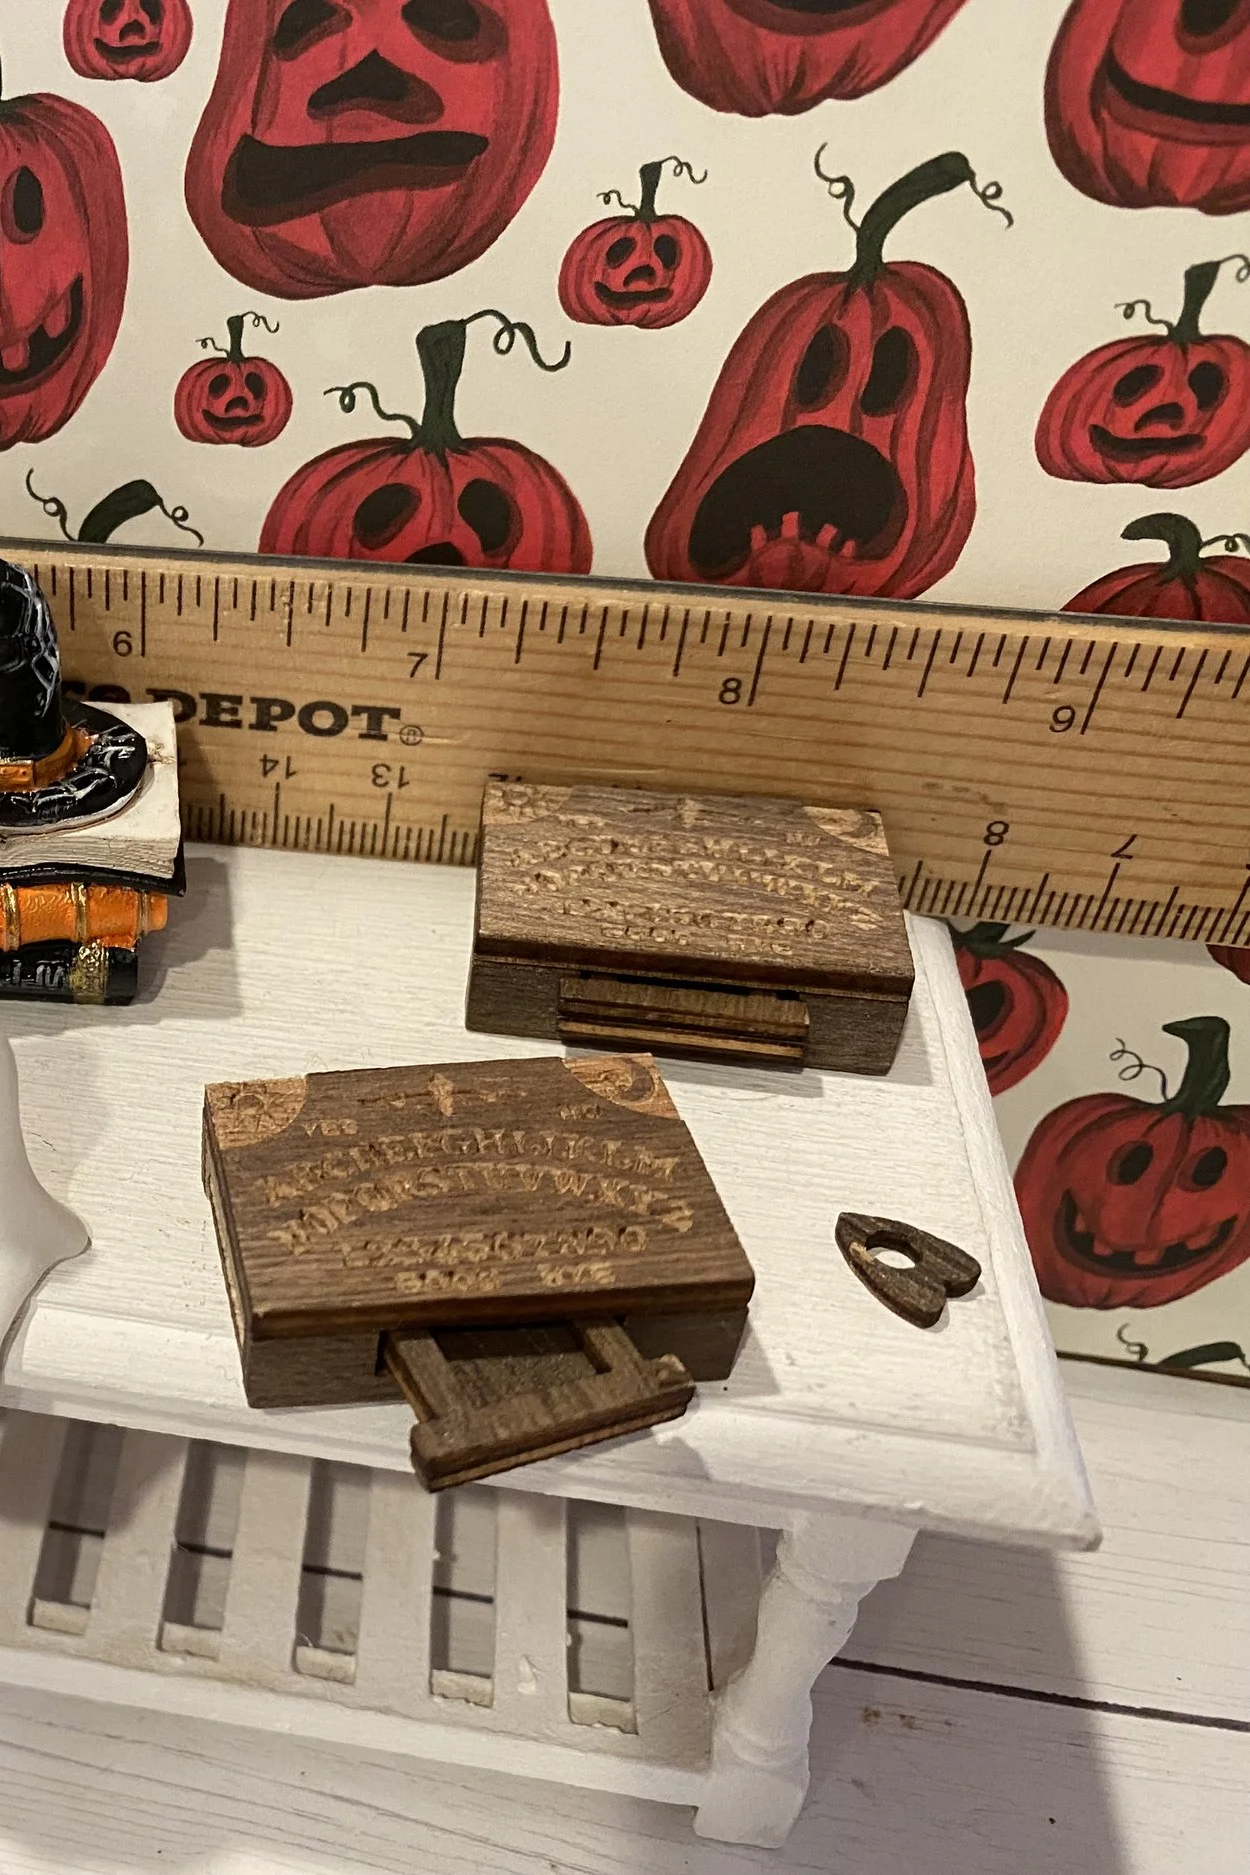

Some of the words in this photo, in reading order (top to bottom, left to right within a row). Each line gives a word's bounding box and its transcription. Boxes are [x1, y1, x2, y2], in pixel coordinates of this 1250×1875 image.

[112, 630, 134, 658] 6
[406, 651, 429, 678] 7
[718, 677, 743, 705] 8
[1049, 705, 1076, 733] 9
[259, 753, 297, 780] 14
[370, 762, 410, 790] 13
[983, 821, 1009, 846] 8
[1110, 833, 1138, 860] 7
